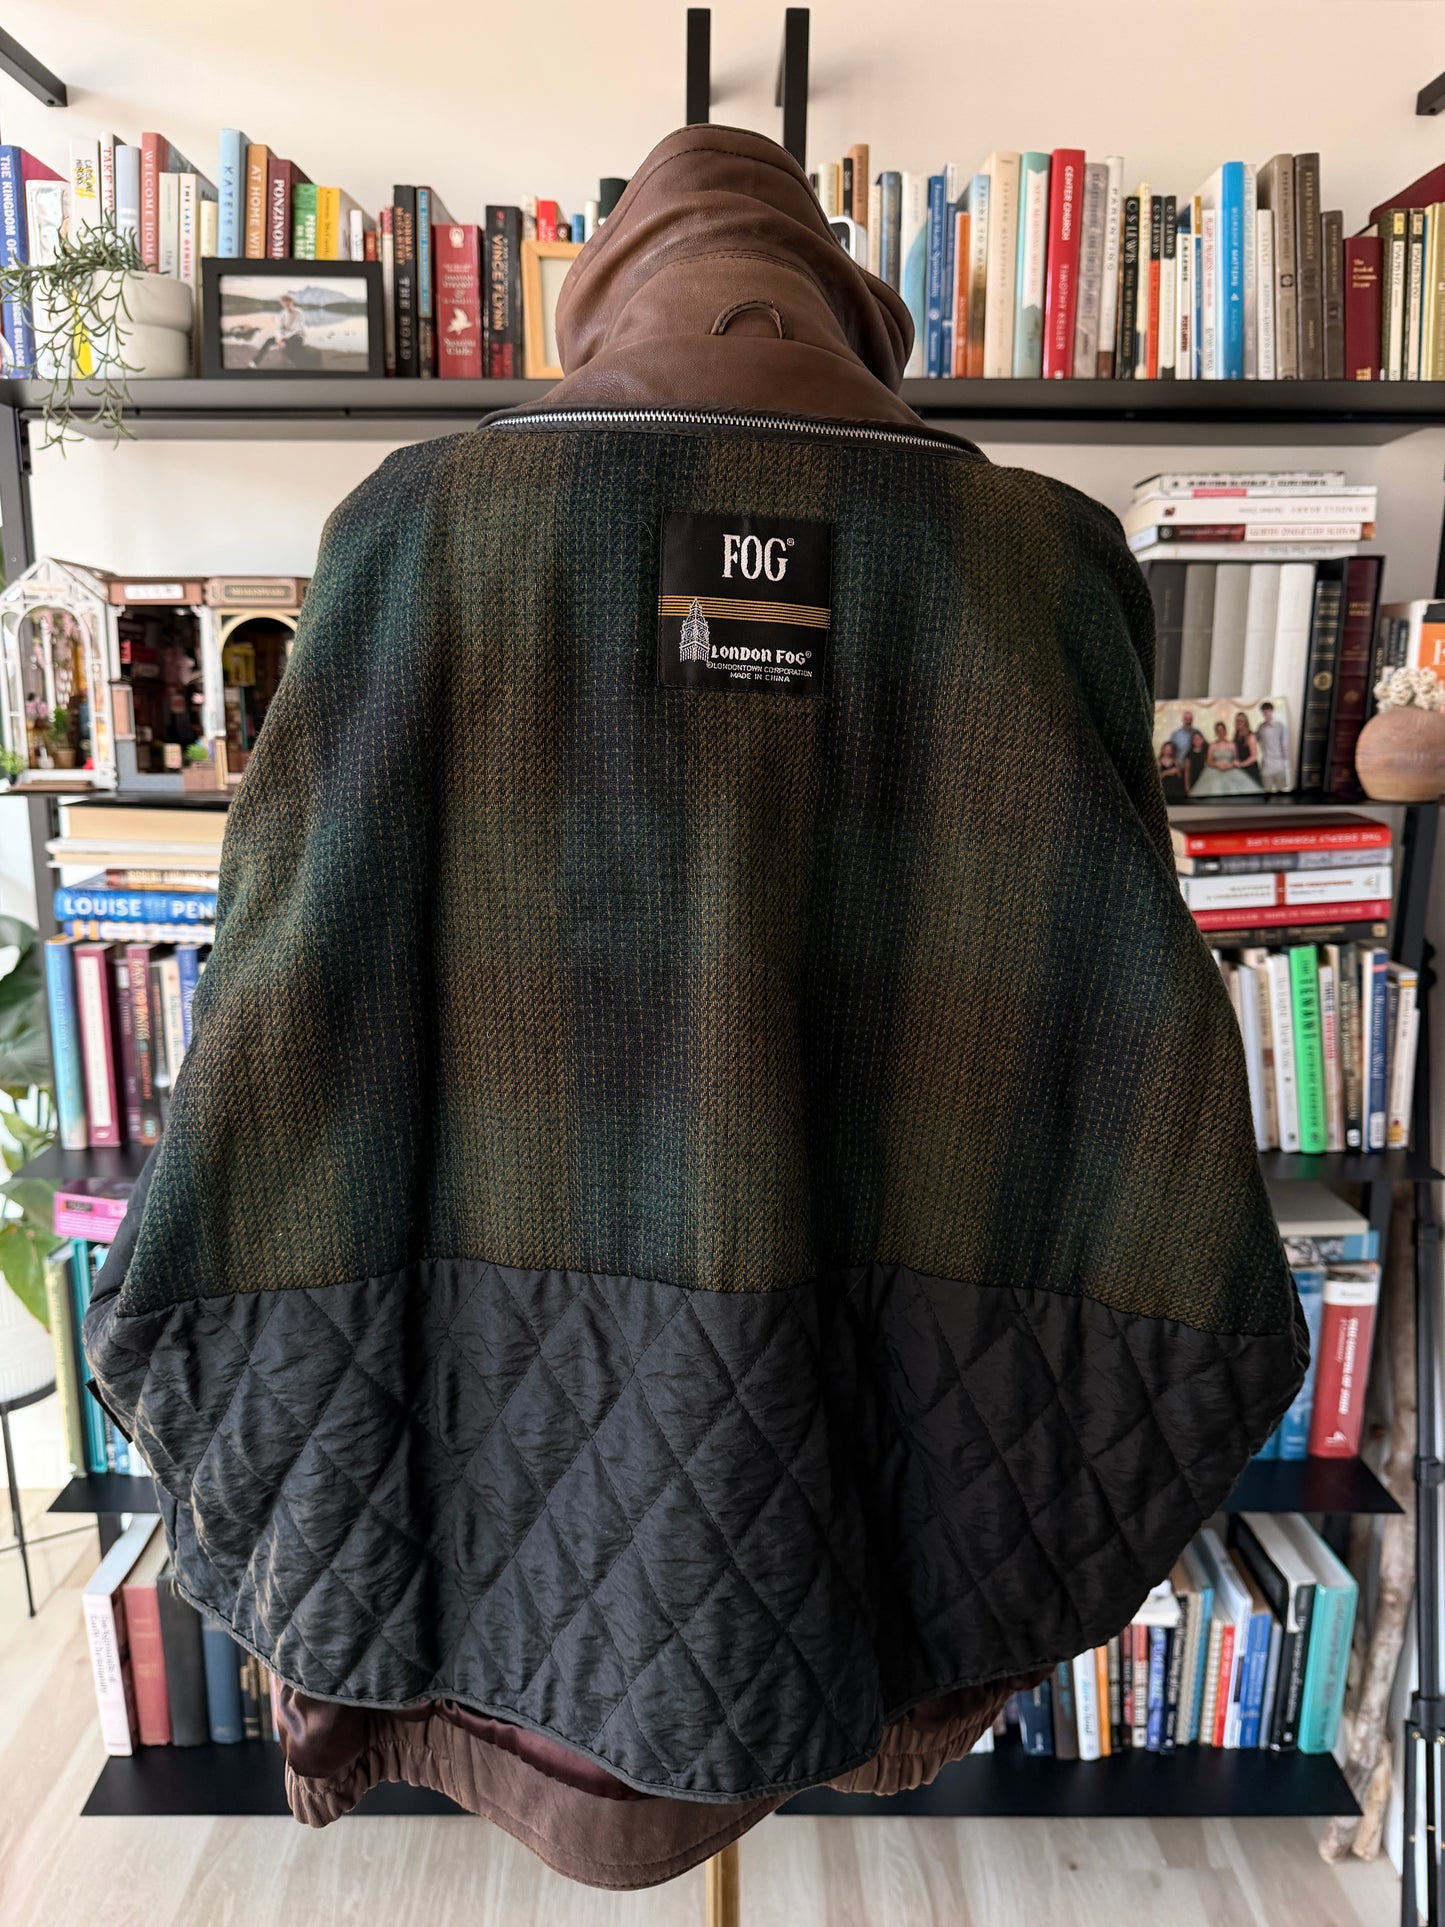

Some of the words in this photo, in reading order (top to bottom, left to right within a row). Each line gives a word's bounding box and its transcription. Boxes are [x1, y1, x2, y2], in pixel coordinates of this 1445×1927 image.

[1, 155, 12, 178] THE
[103, 147, 113, 184] TAKE
[144, 149, 155, 215] WELCOME
[250, 164, 262, 183] AT
[1063, 165, 1074, 201] CENTER
[223, 166, 234, 225] KATE'S
[250, 186, 261, 226] HOME
[1244, 176, 1254, 198] THE
[2, 181, 16, 236] KINGDOM
[1061, 202, 1073, 240] CHURCH
[5, 238, 18, 254] OF
[144, 222, 155, 260] HOME
[305, 214, 316, 251] PEOPLE
[395, 207, 405, 265] McCARTHY
[404, 212, 413, 260] CORMAC
[1107, 187, 1119, 271] PARENTING
[1125, 225, 1138, 264] LEWIS
[1152, 224, 1160, 253] LEWIS
[1166, 224, 1174, 253] LEWIS
[491, 234, 505, 280] VINCE
[1230, 249, 1239, 286] MATTERS
[398, 276, 411, 309] THE
[1058, 264, 1070, 309] TIMOTHY
[491, 284, 505, 330] FLYNN
[14, 327, 25, 367] BULLOCK
[400, 316, 412, 360] ROAD
[1056, 312, 1068, 350] KELLER
[730, 671, 752, 680] MADE
[754, 673, 763, 681] IN
[765, 674, 791, 683] CHINA
[764, 666, 813, 678] CORPORATION
[64, 896, 142, 917] LOUISE
[1300, 978, 1317, 1039] TENANT
